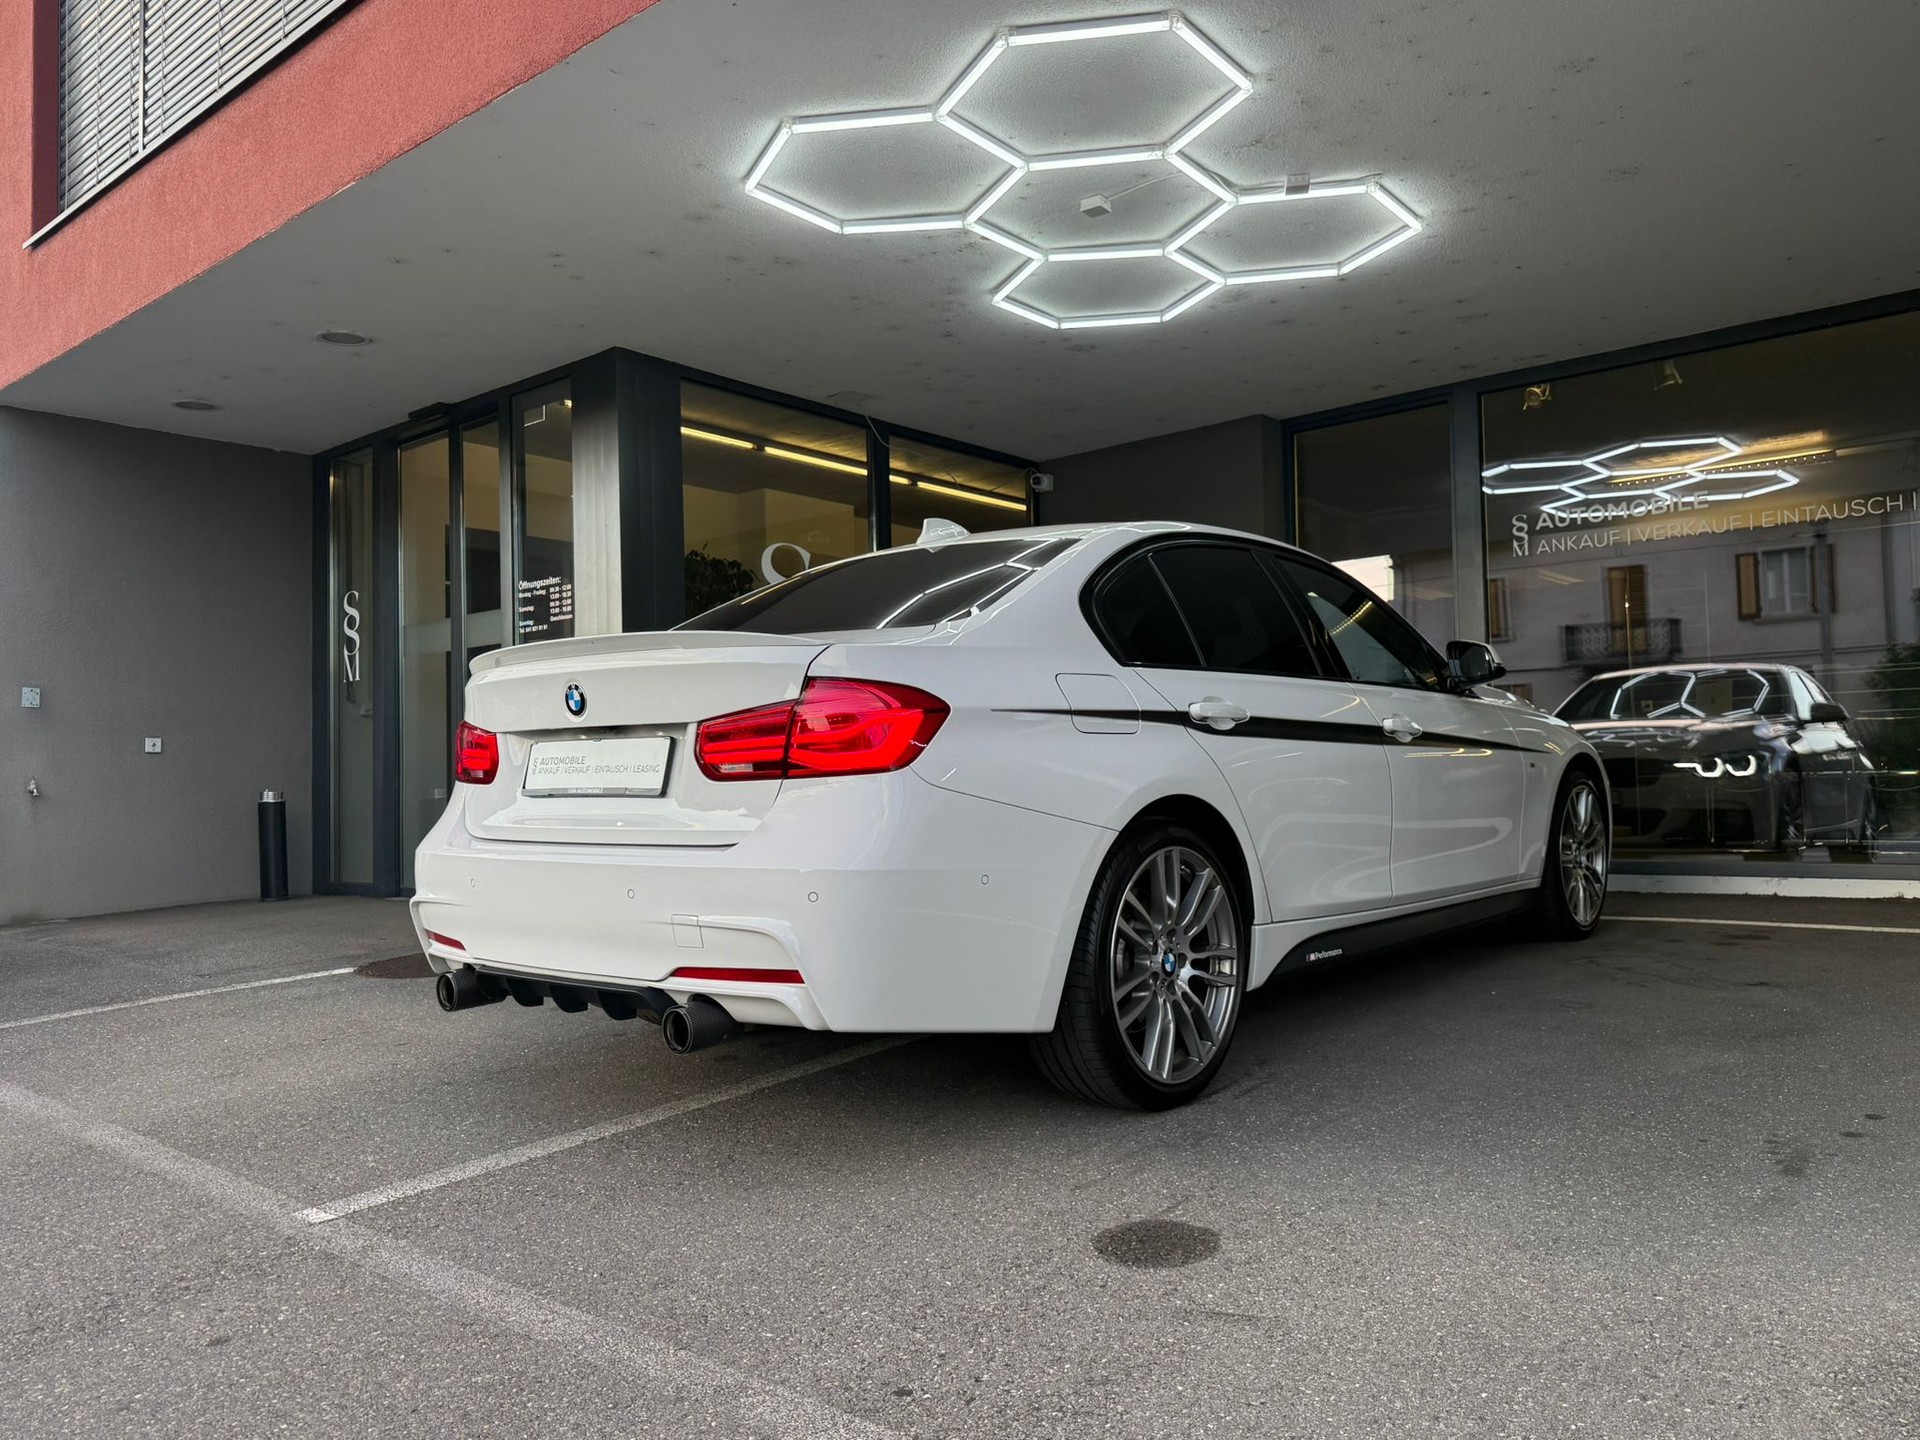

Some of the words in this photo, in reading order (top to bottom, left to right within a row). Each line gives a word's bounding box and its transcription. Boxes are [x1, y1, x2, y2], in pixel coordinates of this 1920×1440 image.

[1535, 490, 1710, 531] AUTOMOBILE
[1536, 529, 1620, 555] ANKAUF
[1636, 513, 1743, 542] VERKAUF
[1761, 494, 1903, 528] EINTAUSCH
[518, 576, 561, 589] Öffnungszeiten:
[540, 756, 585, 765] AUTOMOBILE
[537, 766, 560, 775] ANKAUF
[564, 765, 591, 774] VERKAUF
[594, 765, 628, 773] EINTAUSCH
[632, 764, 661, 773] LEASING
